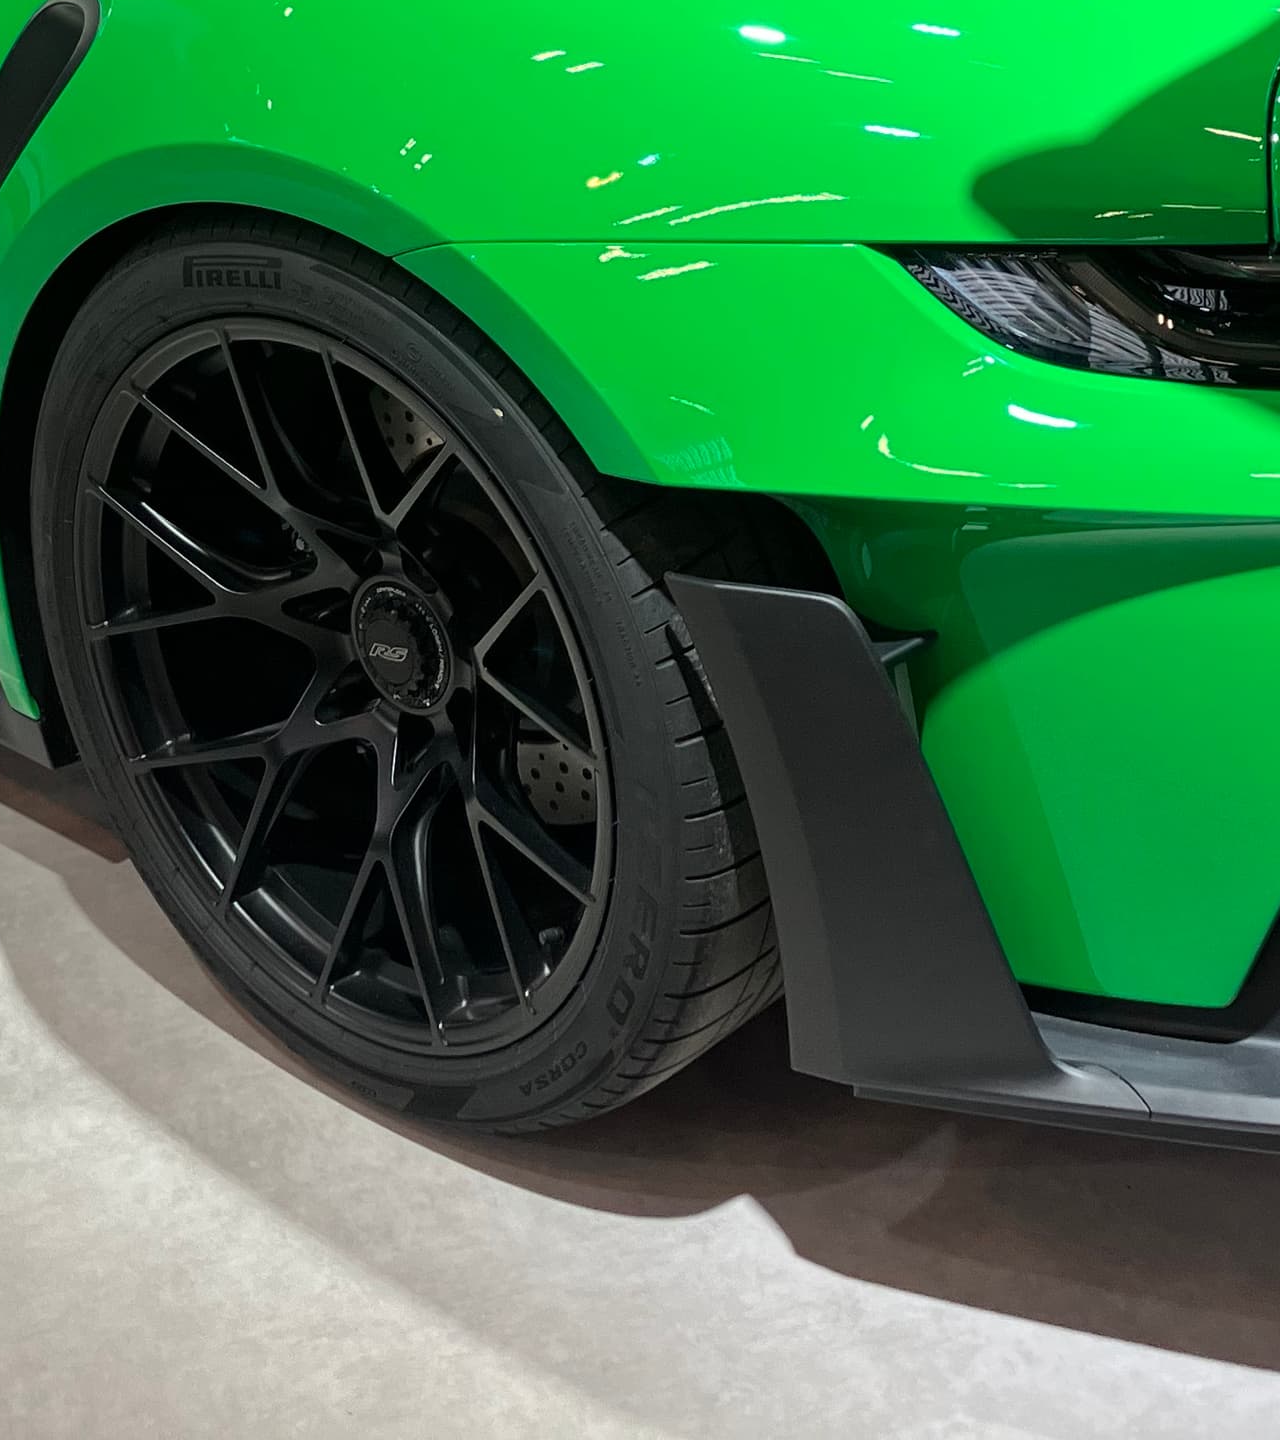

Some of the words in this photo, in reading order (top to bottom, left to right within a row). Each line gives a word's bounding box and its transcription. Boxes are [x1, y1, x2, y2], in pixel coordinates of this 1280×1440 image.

[182, 256, 282, 290] PIRELLI
[369, 642, 408, 661] RS
[520, 1041, 588, 1097] CORSA
